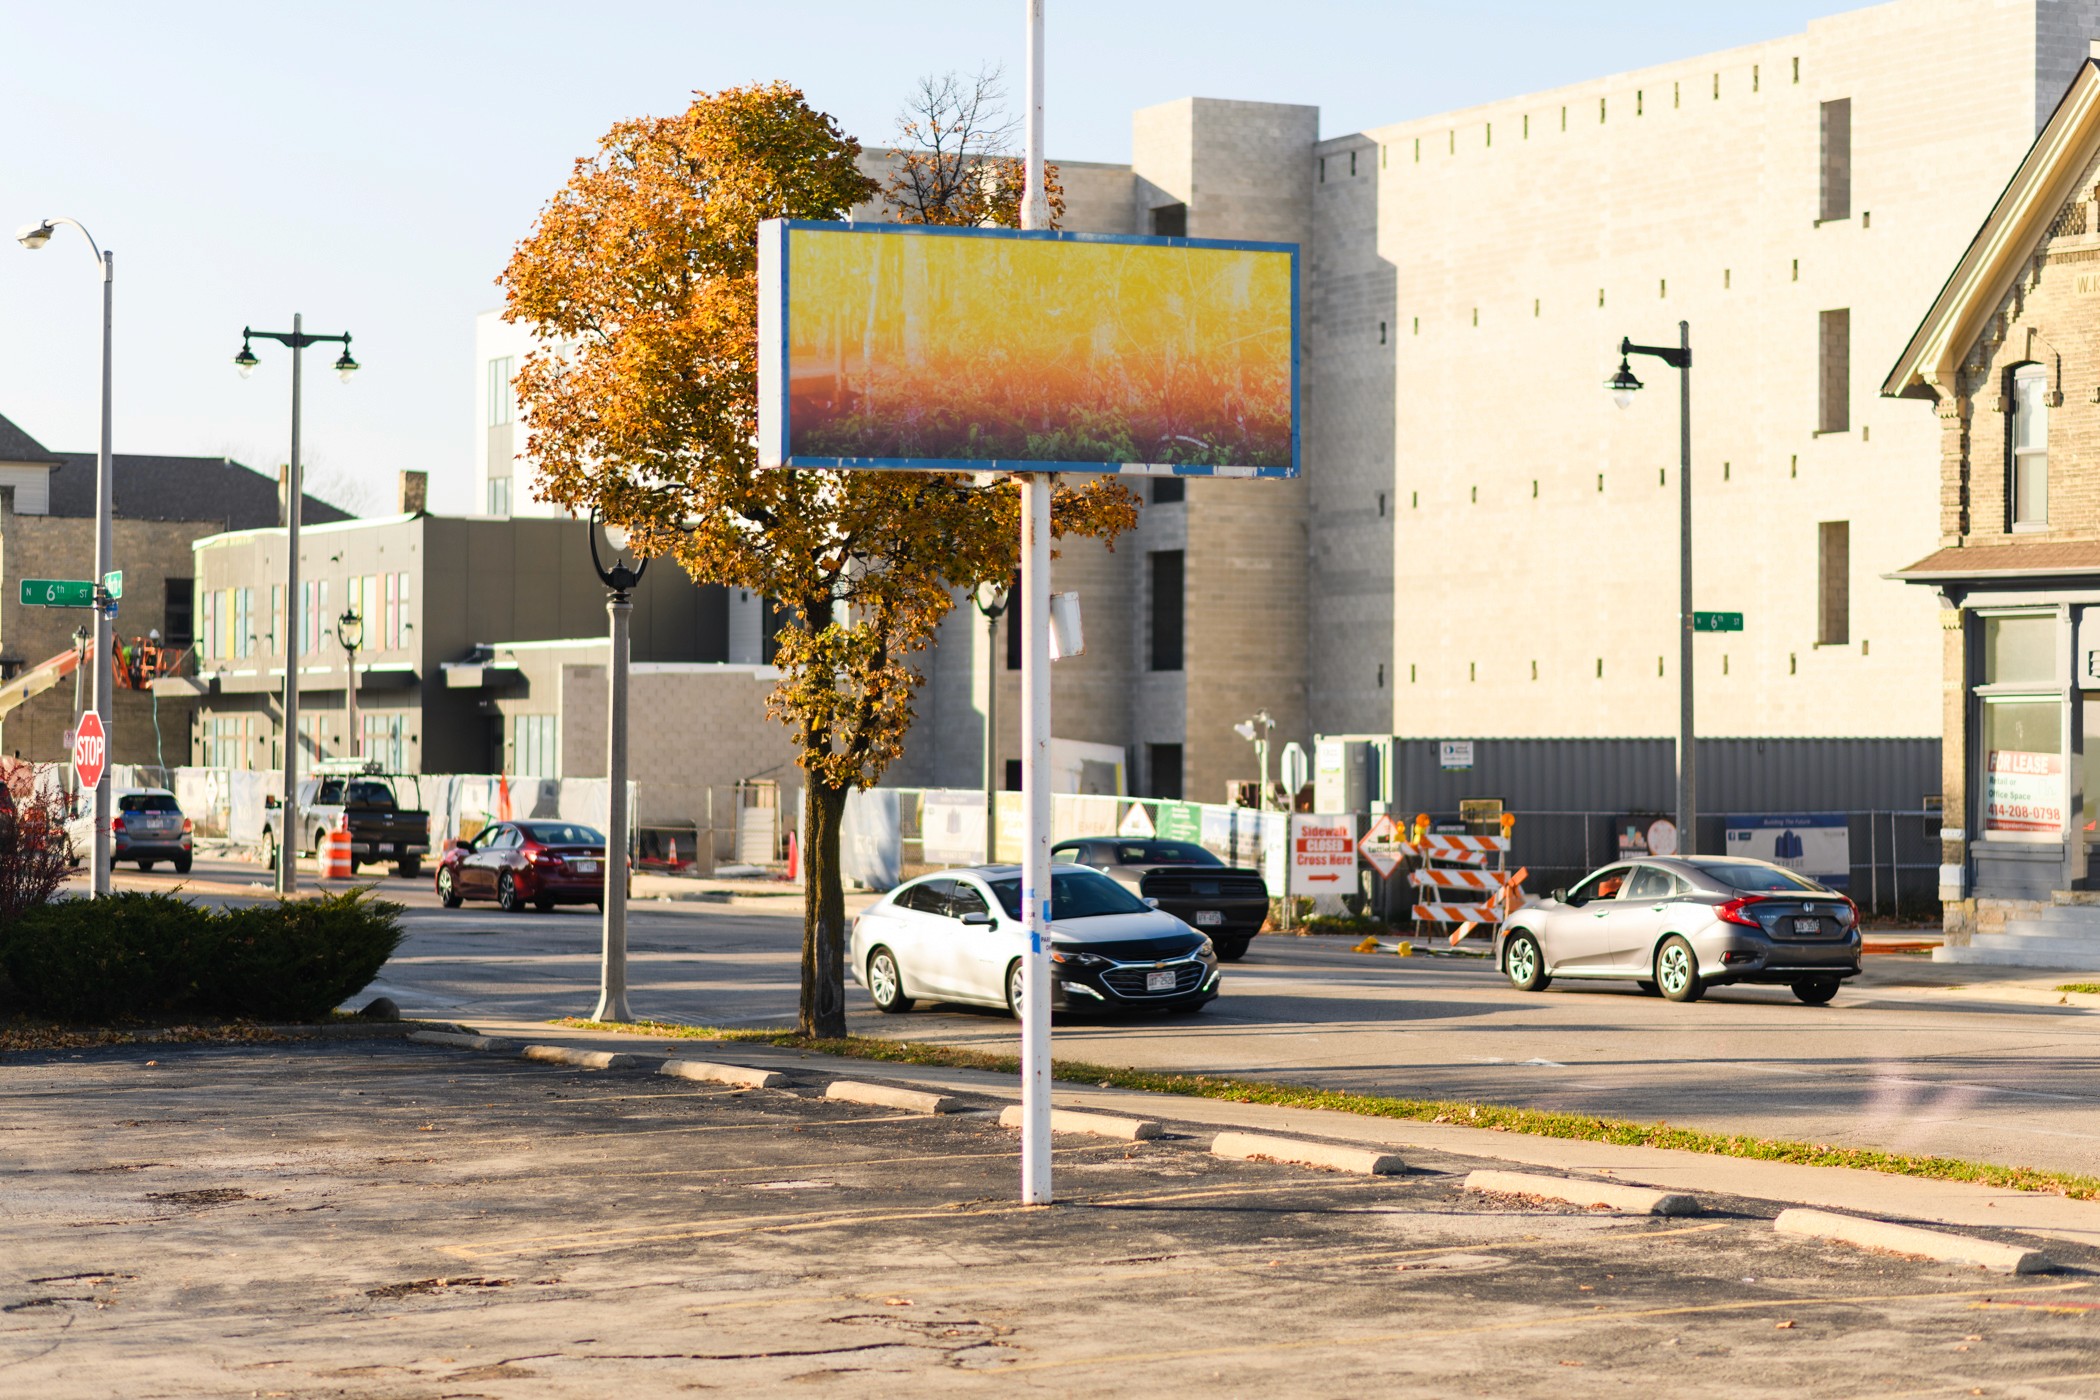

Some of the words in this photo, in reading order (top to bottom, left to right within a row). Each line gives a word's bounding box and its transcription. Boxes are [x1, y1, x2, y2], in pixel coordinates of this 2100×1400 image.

[25, 587, 32, 596] N
[46, 584, 65, 602] 6th
[79, 589, 88, 598] ST
[1733, 617, 1740, 626] ST
[77, 735, 103, 767] STOP
[1989, 752, 2011, 771] FOR
[2012, 753, 2049, 774] LEASE
[1989, 775, 2008, 785] Retail
[2009, 778, 2017, 786] or
[1988, 788, 2009, 799] Office
[2009, 790, 2032, 801] Space
[1988, 803, 2061, 821] 414-208-0798
[1763, 818, 1784, 826] Building
[1301, 825, 1348, 837] Sidewalk
[1306, 839, 1344, 852] CLOSED
[1297, 853, 1327, 866] Cross
[1329, 853, 1353, 866] Here
